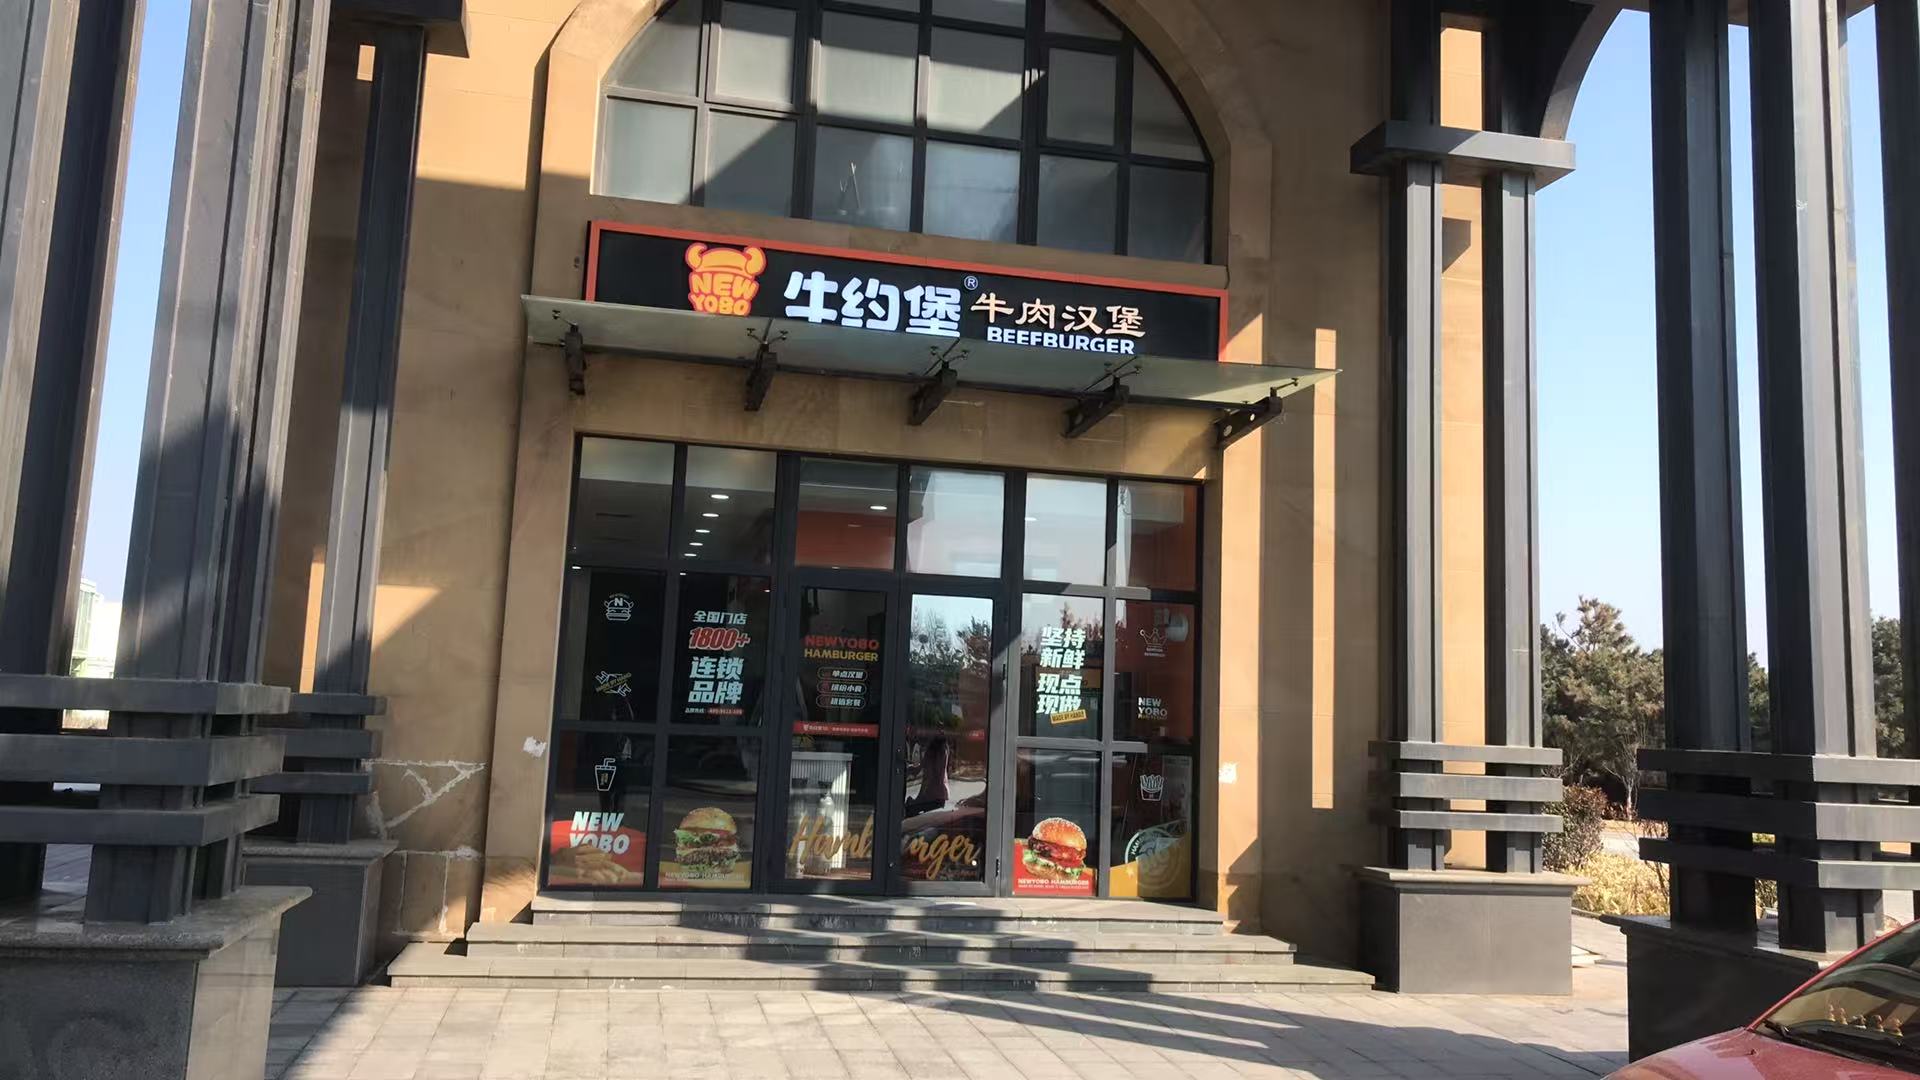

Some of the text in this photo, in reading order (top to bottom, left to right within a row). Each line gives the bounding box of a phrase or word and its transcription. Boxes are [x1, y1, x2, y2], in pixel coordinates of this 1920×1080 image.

[689, 272, 759, 300] NEW
[688, 293, 751, 316] YOBO
[784, 271, 961, 338] 牛约堡
[970, 292, 1146, 338] 牛肉汉堡
[987, 326, 1135, 355] BEEFBURGER
[692, 610, 748, 625] 全国门店
[688, 627, 751, 651] 1800+
[804, 635, 880, 650] NEWYOBO
[1040, 626, 1086, 649] 坚持
[804, 648, 879, 662] HAMBURGER
[1040, 647, 1086, 670] 新鲜
[689, 656, 745, 680] 连锁
[688, 680, 744, 705] 品牌
[1036, 673, 1083, 695] 现点
[1036, 694, 1082, 715] 现做
[1138, 697, 1162, 707] NEW
[571, 811, 624, 833] NEW
[569, 831, 631, 855] YOBO
